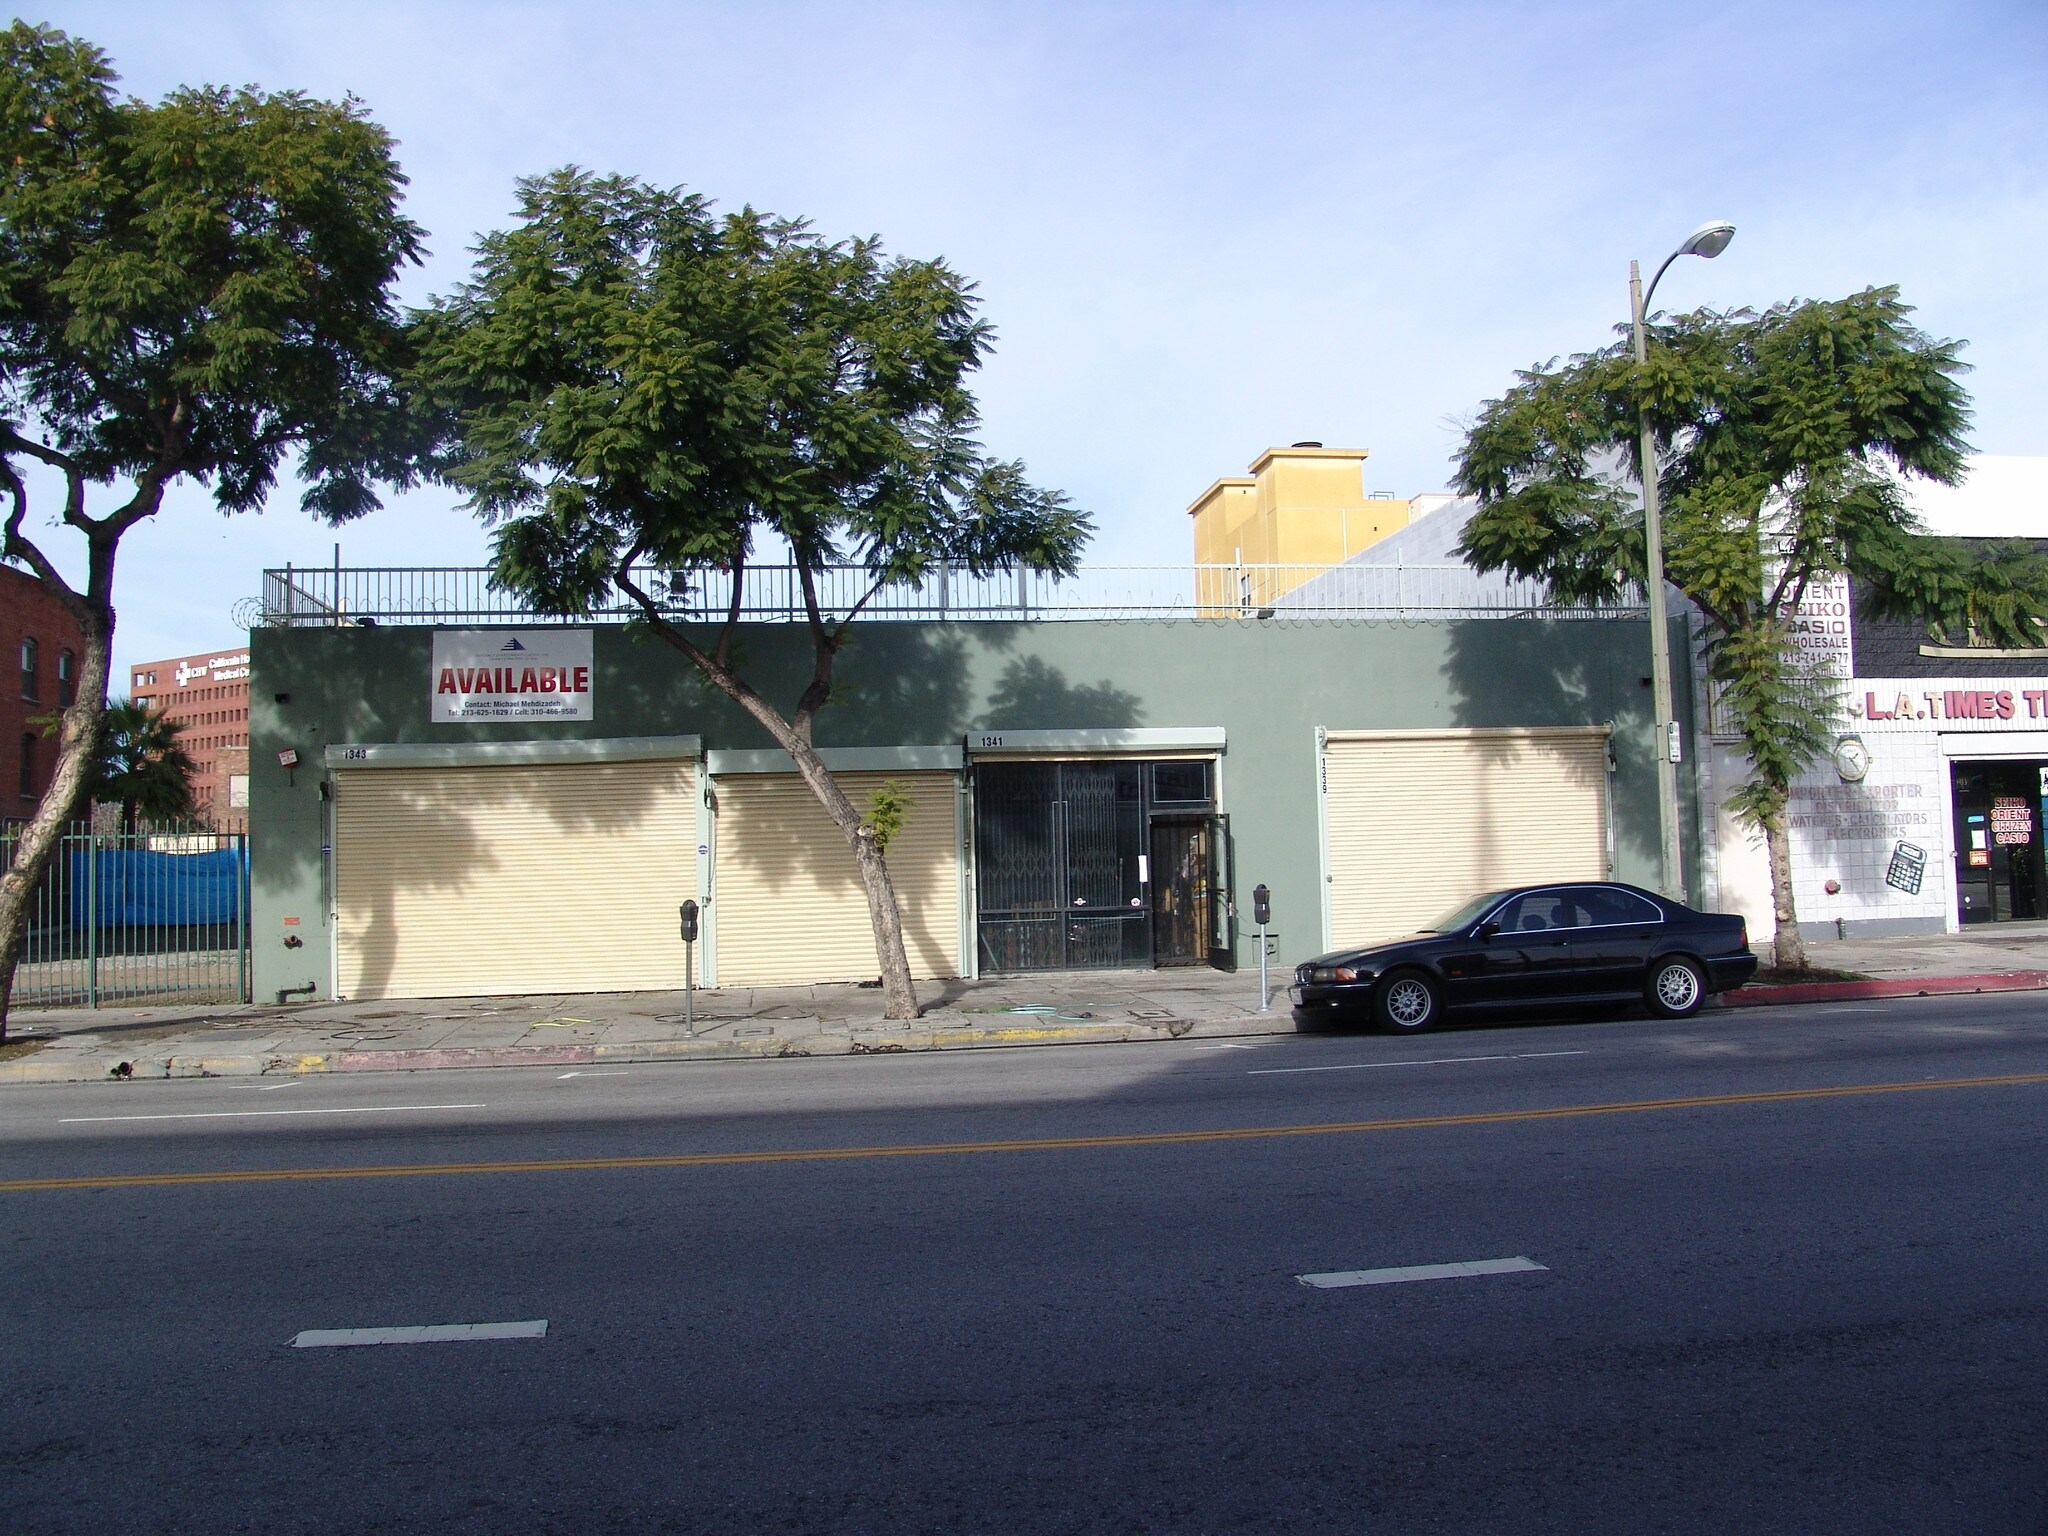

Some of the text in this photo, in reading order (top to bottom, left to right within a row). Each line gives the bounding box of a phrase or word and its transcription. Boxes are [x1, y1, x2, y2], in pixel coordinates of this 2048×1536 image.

[1782, 637, 1848, 648] WHOLESALE
[1783, 652, 1849, 663] 213-741-0577
[438, 667, 588, 694] AVAILABLE
[981, 737, 1003, 746] 1341
[344, 750, 367, 759] 1343
[1991, 809, 2030, 820] ORIENT
[1991, 821, 2031, 831] CITIZEN
[1996, 833, 2029, 843] CASIO
